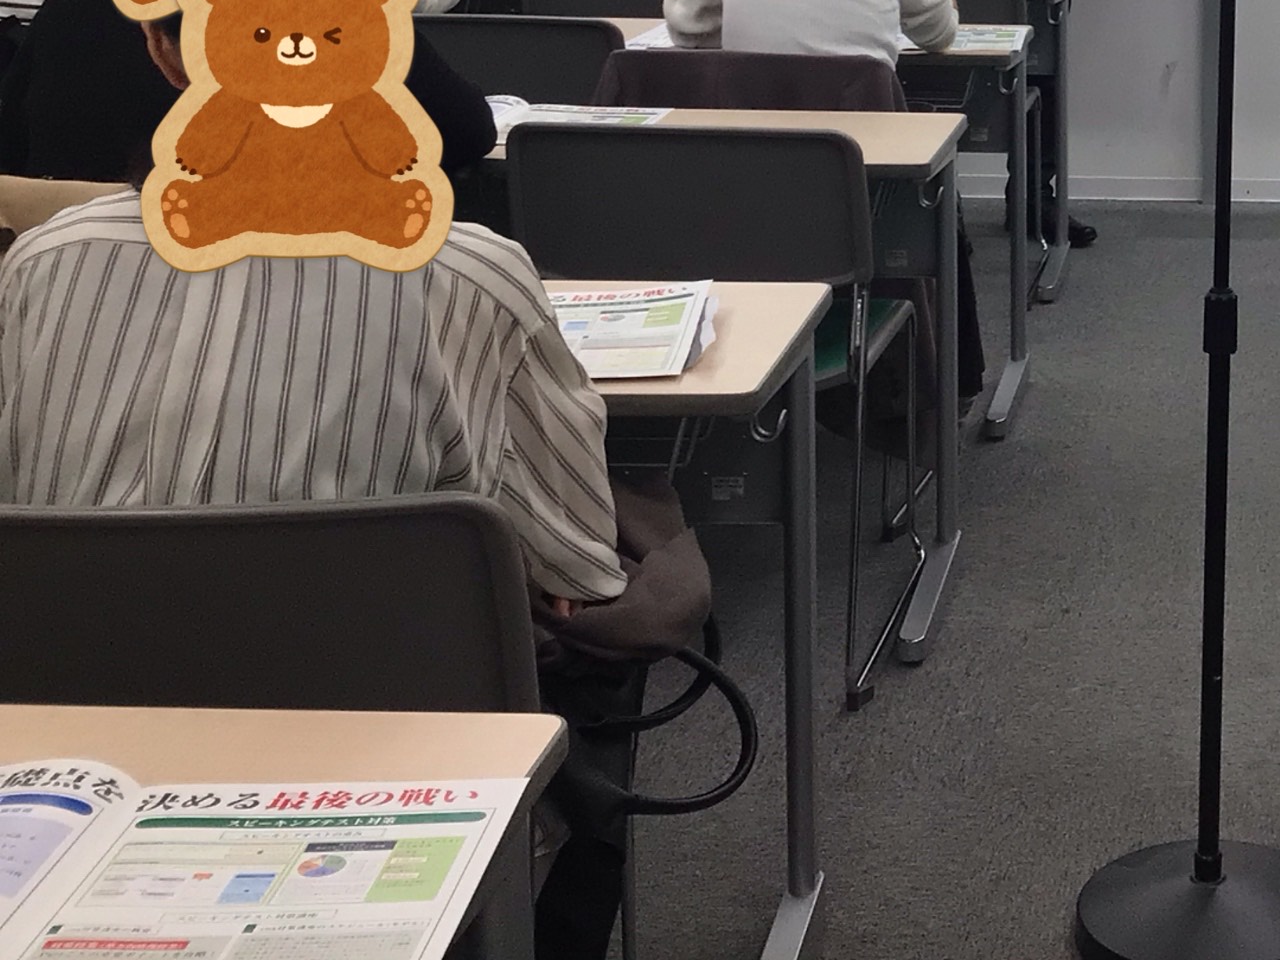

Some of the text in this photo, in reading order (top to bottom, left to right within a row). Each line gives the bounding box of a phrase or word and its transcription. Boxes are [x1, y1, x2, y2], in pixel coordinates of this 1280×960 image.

[0, 768, 124, 804] 礎点を
[135, 788, 479, 813] 決める最後の戦い
